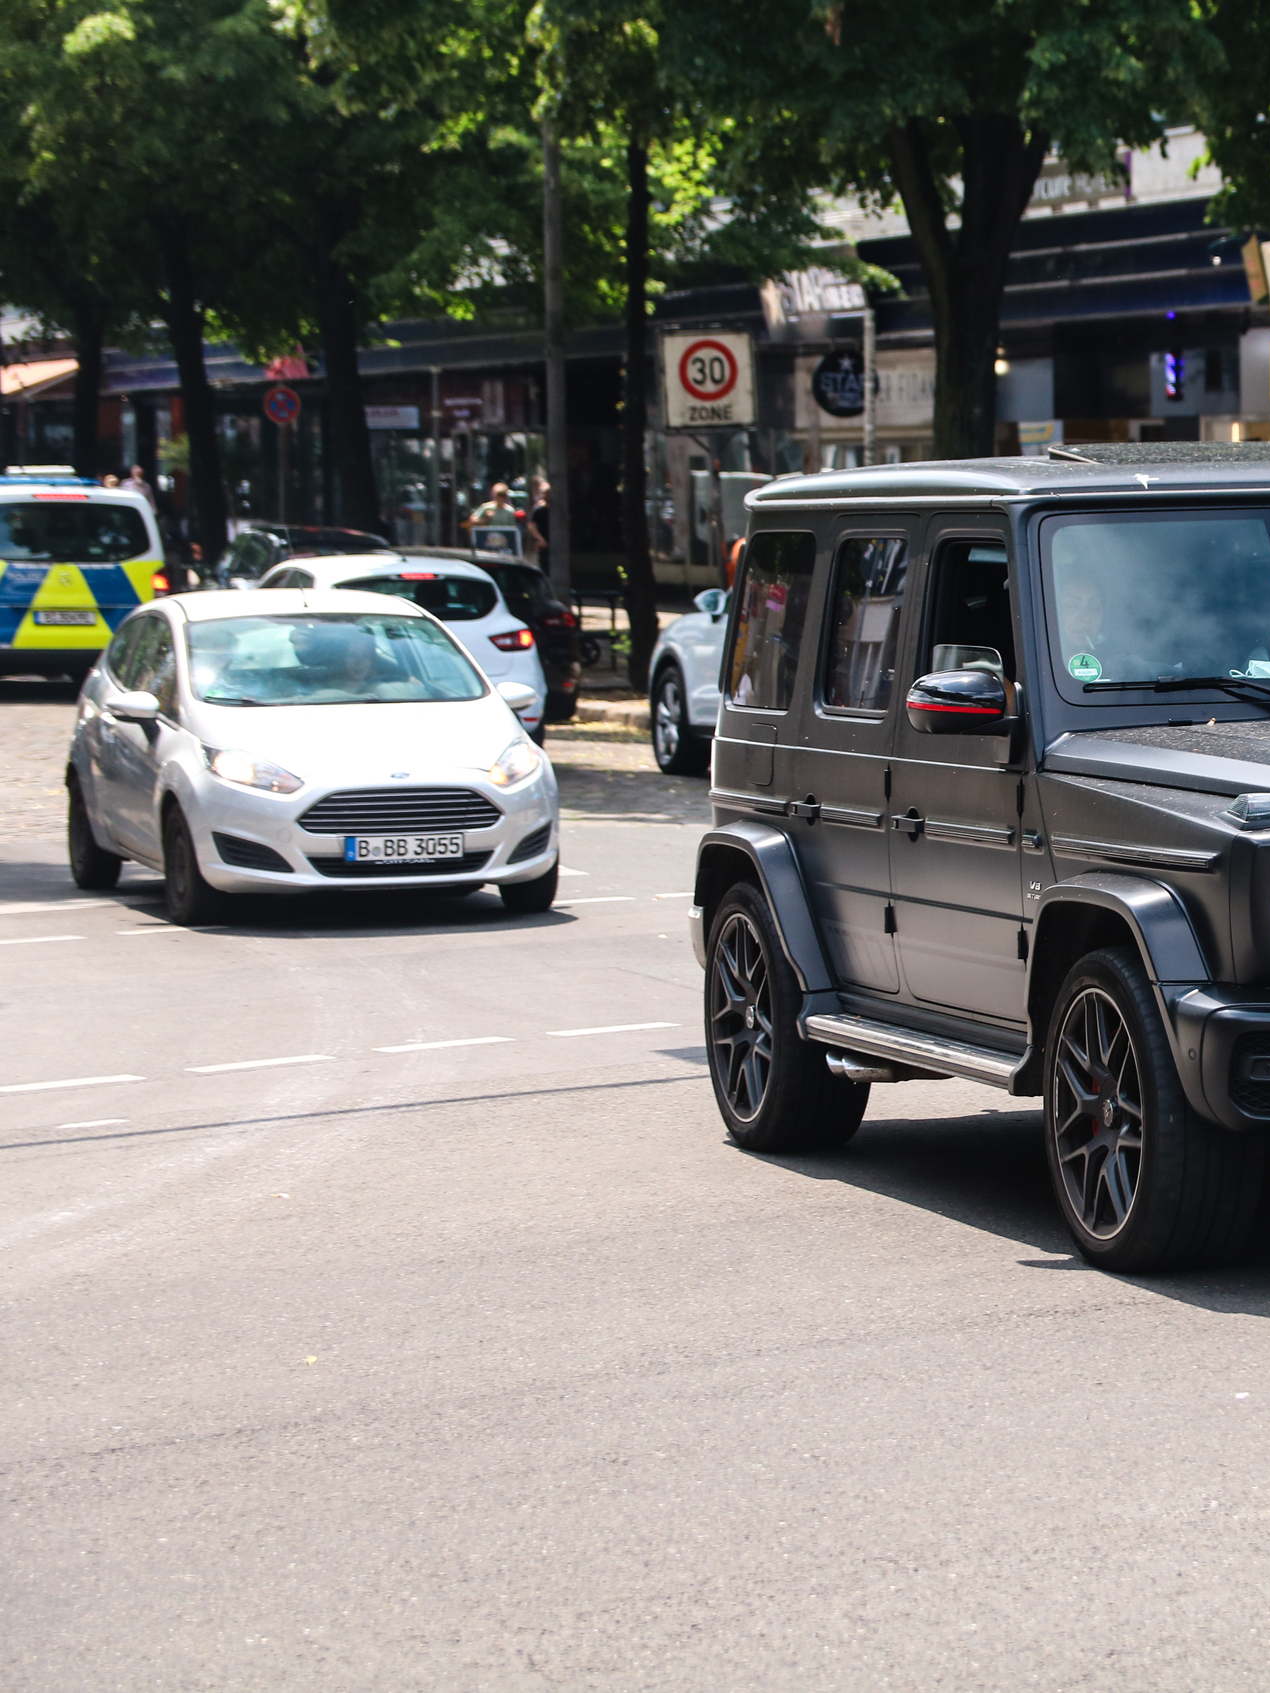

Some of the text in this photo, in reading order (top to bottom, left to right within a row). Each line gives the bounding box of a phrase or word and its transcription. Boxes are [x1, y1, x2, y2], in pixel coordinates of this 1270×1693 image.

[691, 356, 726, 386] 30
[688, 404, 733, 422] ZONE
[1080, 655, 1090, 669] 4
[358, 836, 460, 858] B BB 3055
[1029, 880, 1042, 891] V8
